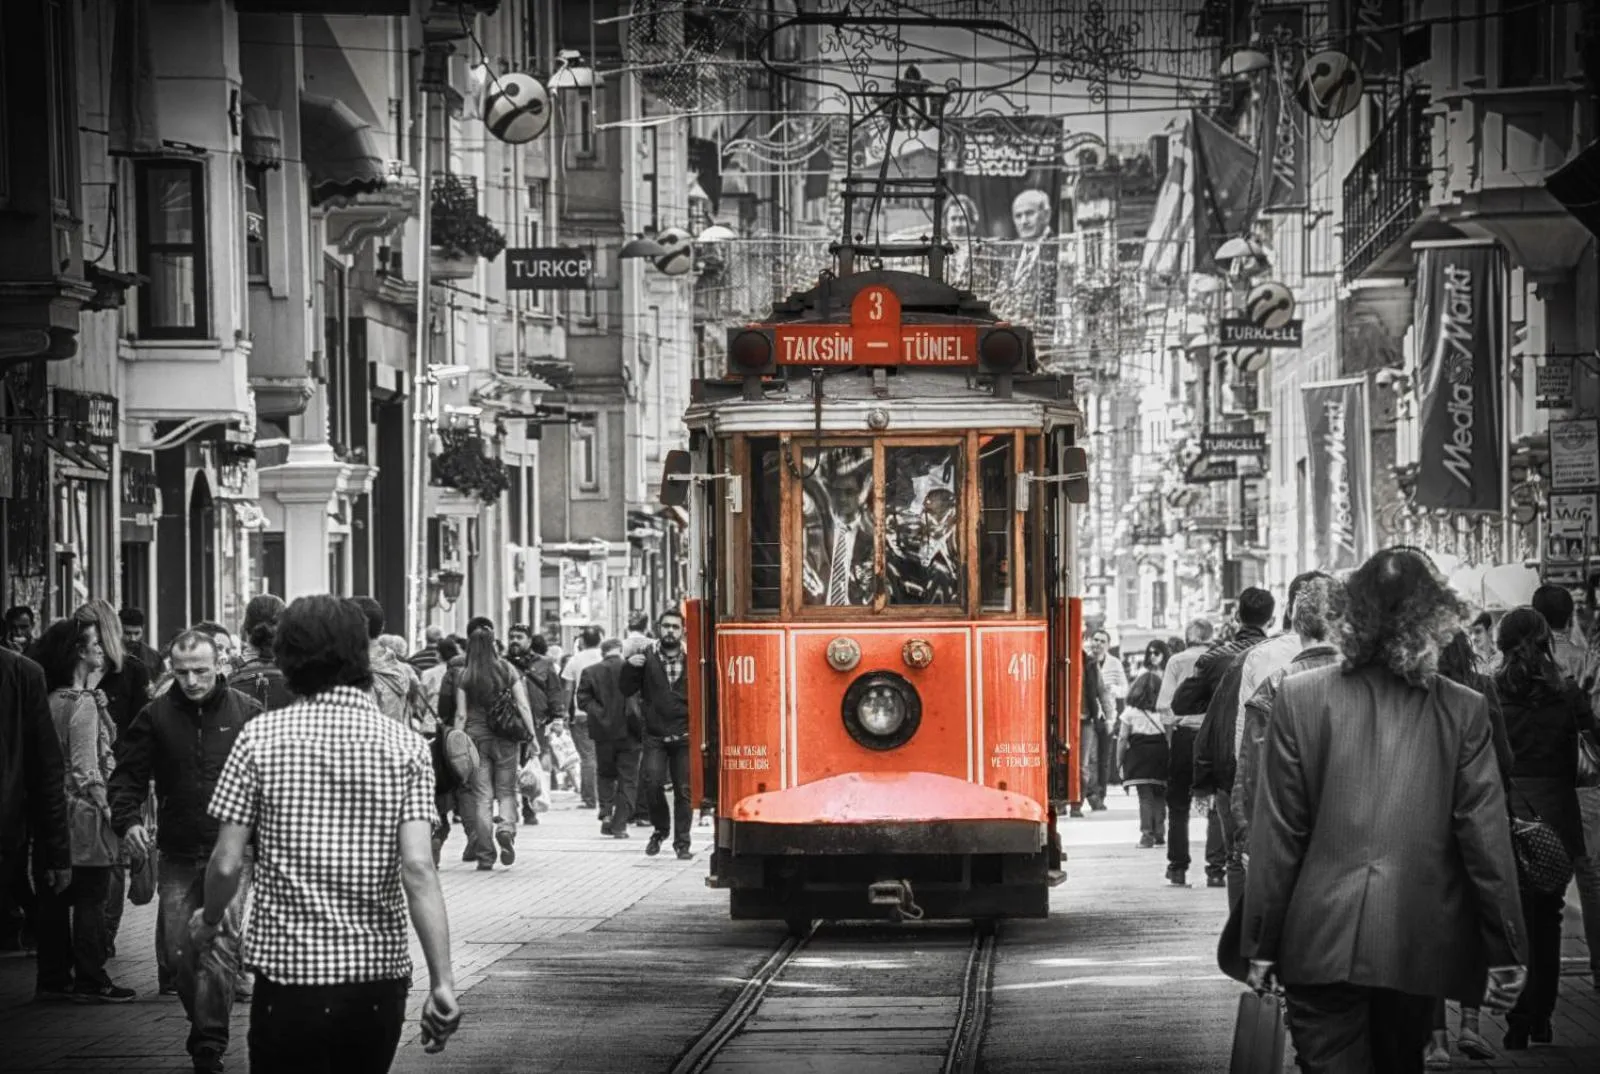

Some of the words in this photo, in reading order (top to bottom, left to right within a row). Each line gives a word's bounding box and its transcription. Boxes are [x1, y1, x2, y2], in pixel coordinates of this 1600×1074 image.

[869, 291, 883, 321] 3
[1442, 263, 1474, 360] Markt
[902, 332, 969, 362] TÜNEL
[1226, 326, 1299, 341] TURKCELL
[1204, 438, 1263, 451] TURKCELL
[1323, 400, 1348, 465] Markt
[1443, 382, 1474, 488] Media
[1330, 480, 1357, 554] Media
[727, 655, 755, 684] 410
[1007, 651, 1037, 681] 410
[991, 756, 1002, 768] VE
